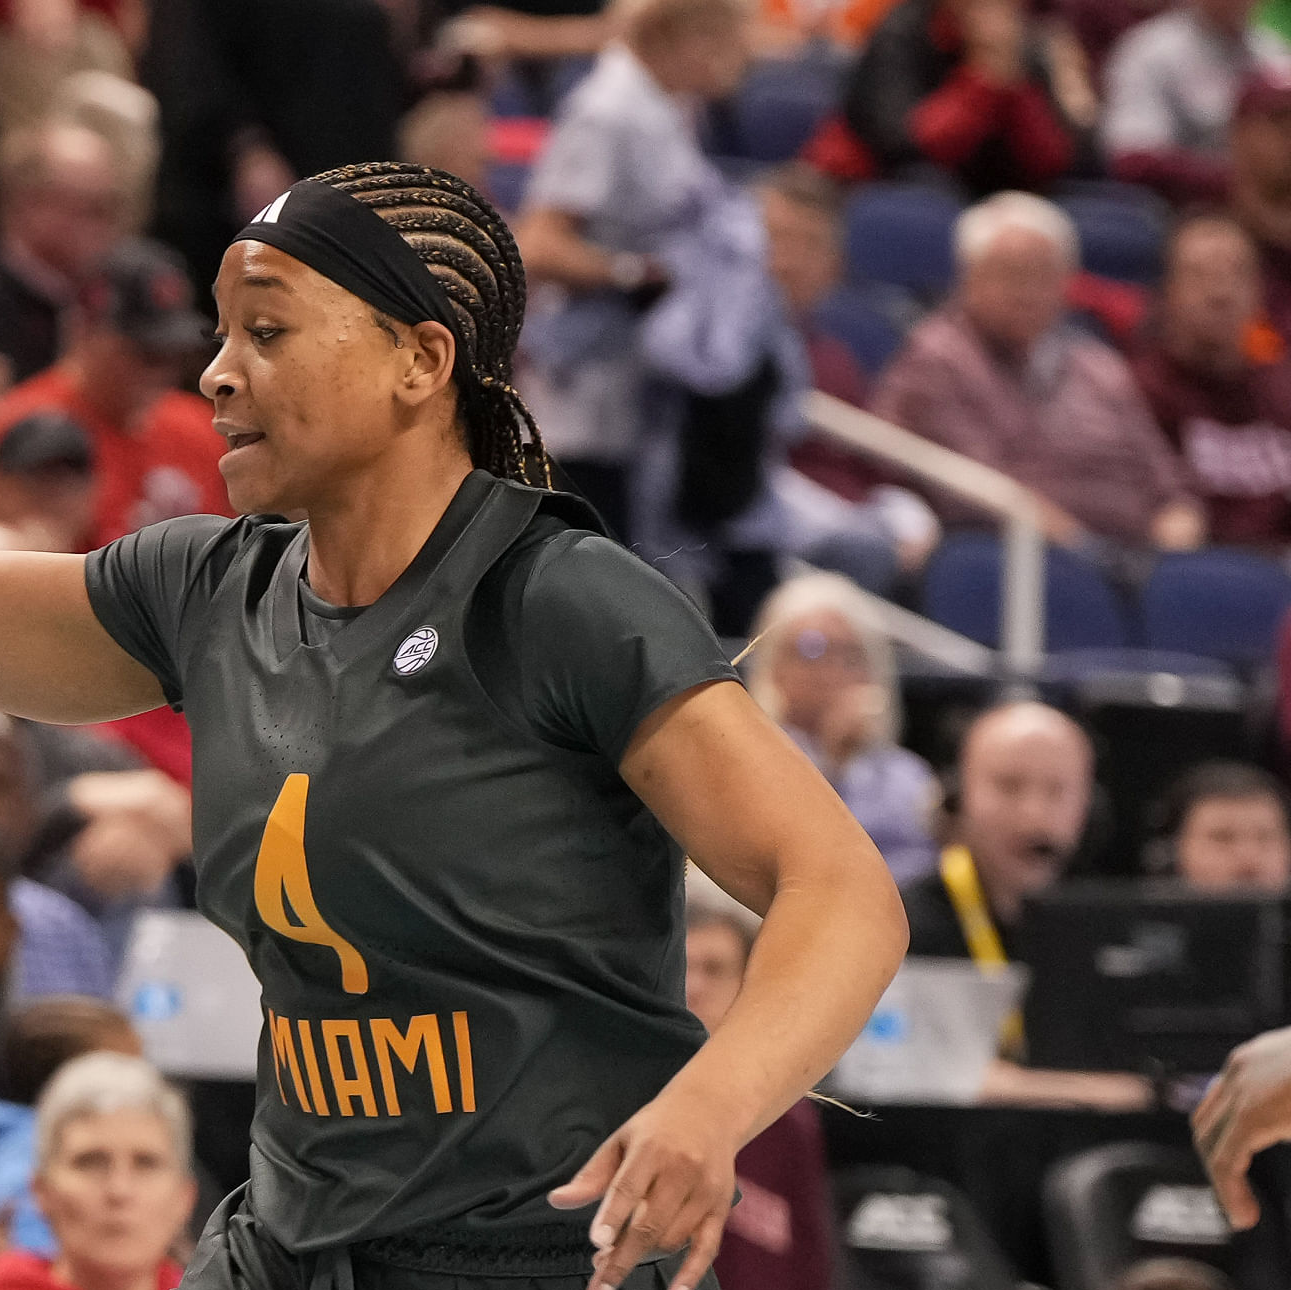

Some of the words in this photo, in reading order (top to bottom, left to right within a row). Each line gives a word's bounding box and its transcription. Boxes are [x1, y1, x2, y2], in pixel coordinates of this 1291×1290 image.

[401, 640, 435, 656] ACC
[254, 773, 368, 994] 4
[268, 1008, 476, 1117] MIAMI
